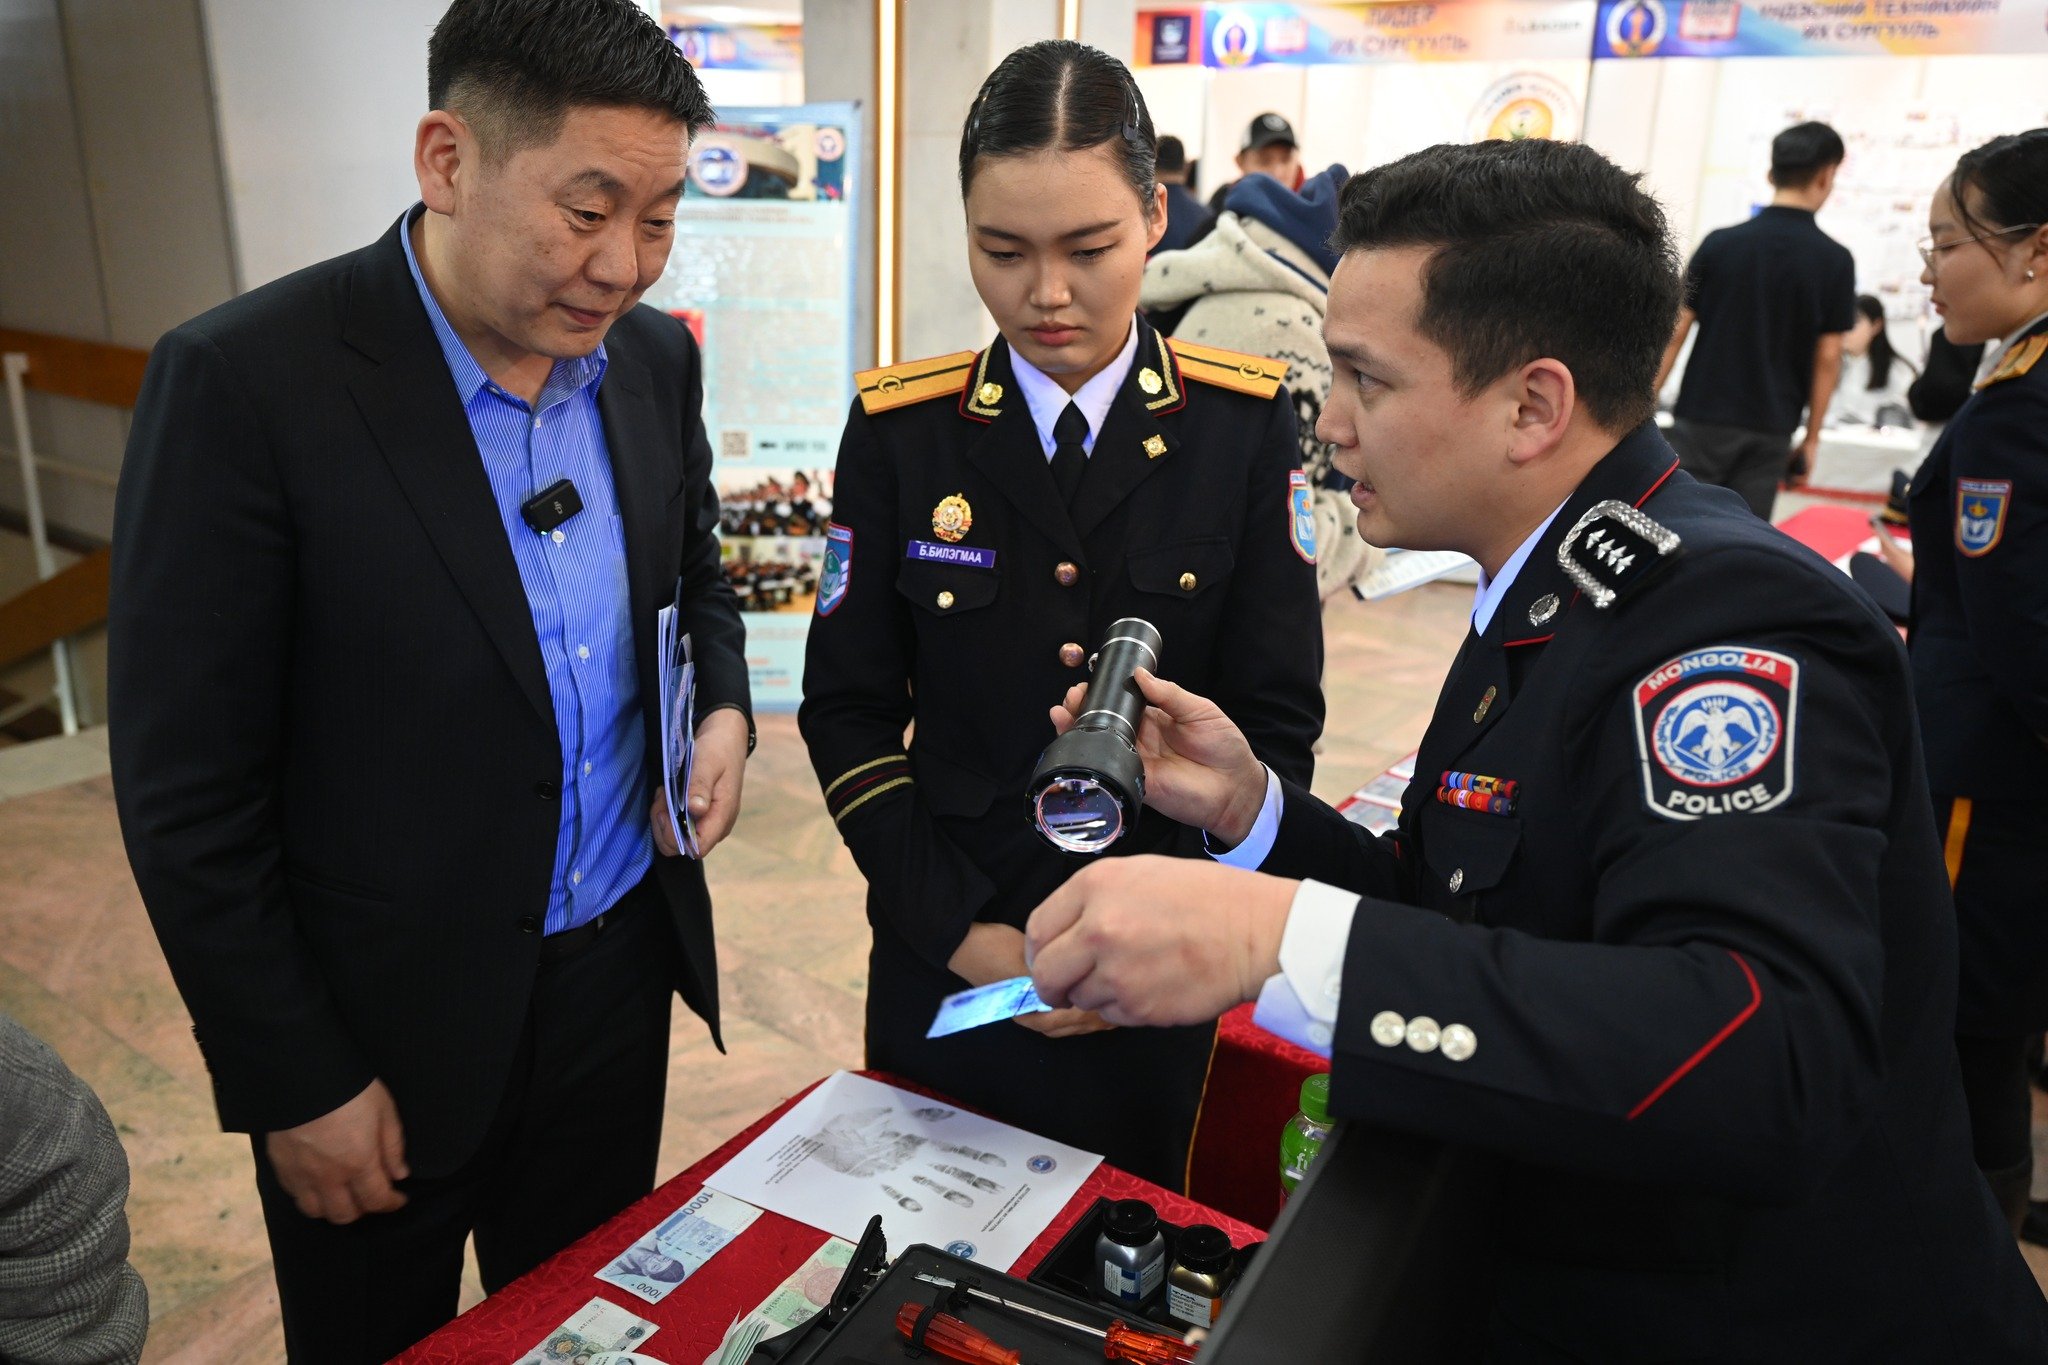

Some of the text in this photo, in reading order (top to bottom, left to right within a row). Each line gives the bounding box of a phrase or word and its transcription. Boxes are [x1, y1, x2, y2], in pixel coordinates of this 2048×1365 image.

[919, 545, 982, 563] Б.БИЛЭГМАА
[1647, 652, 1777, 691] MONGOLIA
[1681, 763, 1750, 783] POLICE
[1667, 782, 1771, 814] POLICE
[683, 1192, 713, 1215] 1000
[636, 1282, 662, 1299] 1000
